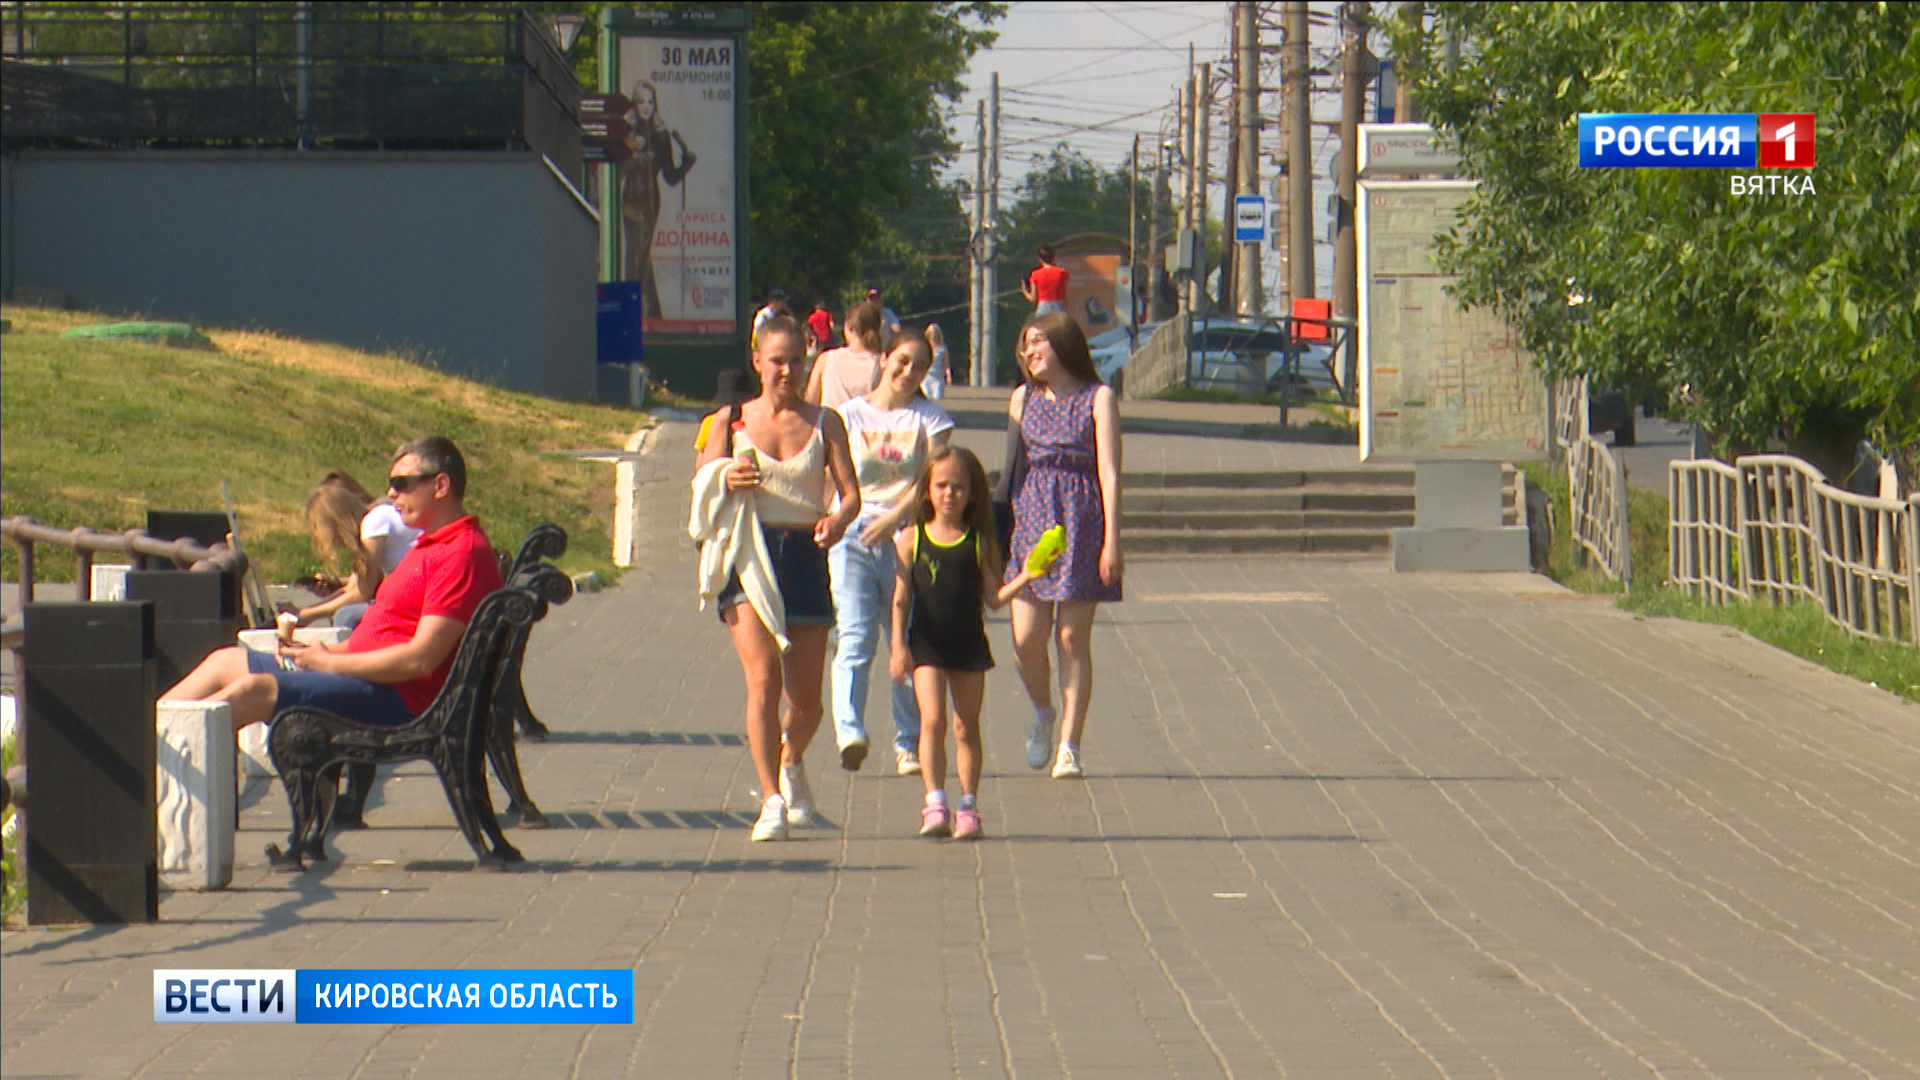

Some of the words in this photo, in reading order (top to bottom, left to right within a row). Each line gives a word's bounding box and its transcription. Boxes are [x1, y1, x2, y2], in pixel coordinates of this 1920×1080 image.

[661, 46, 682, 66] 30
[688, 47, 731, 66] МАЯ
[651, 70, 732, 84] ФИЛАРМОНИЯ
[675, 211, 728, 224] ЛАРИСА
[655, 229, 731, 247] ДОЛИНА
